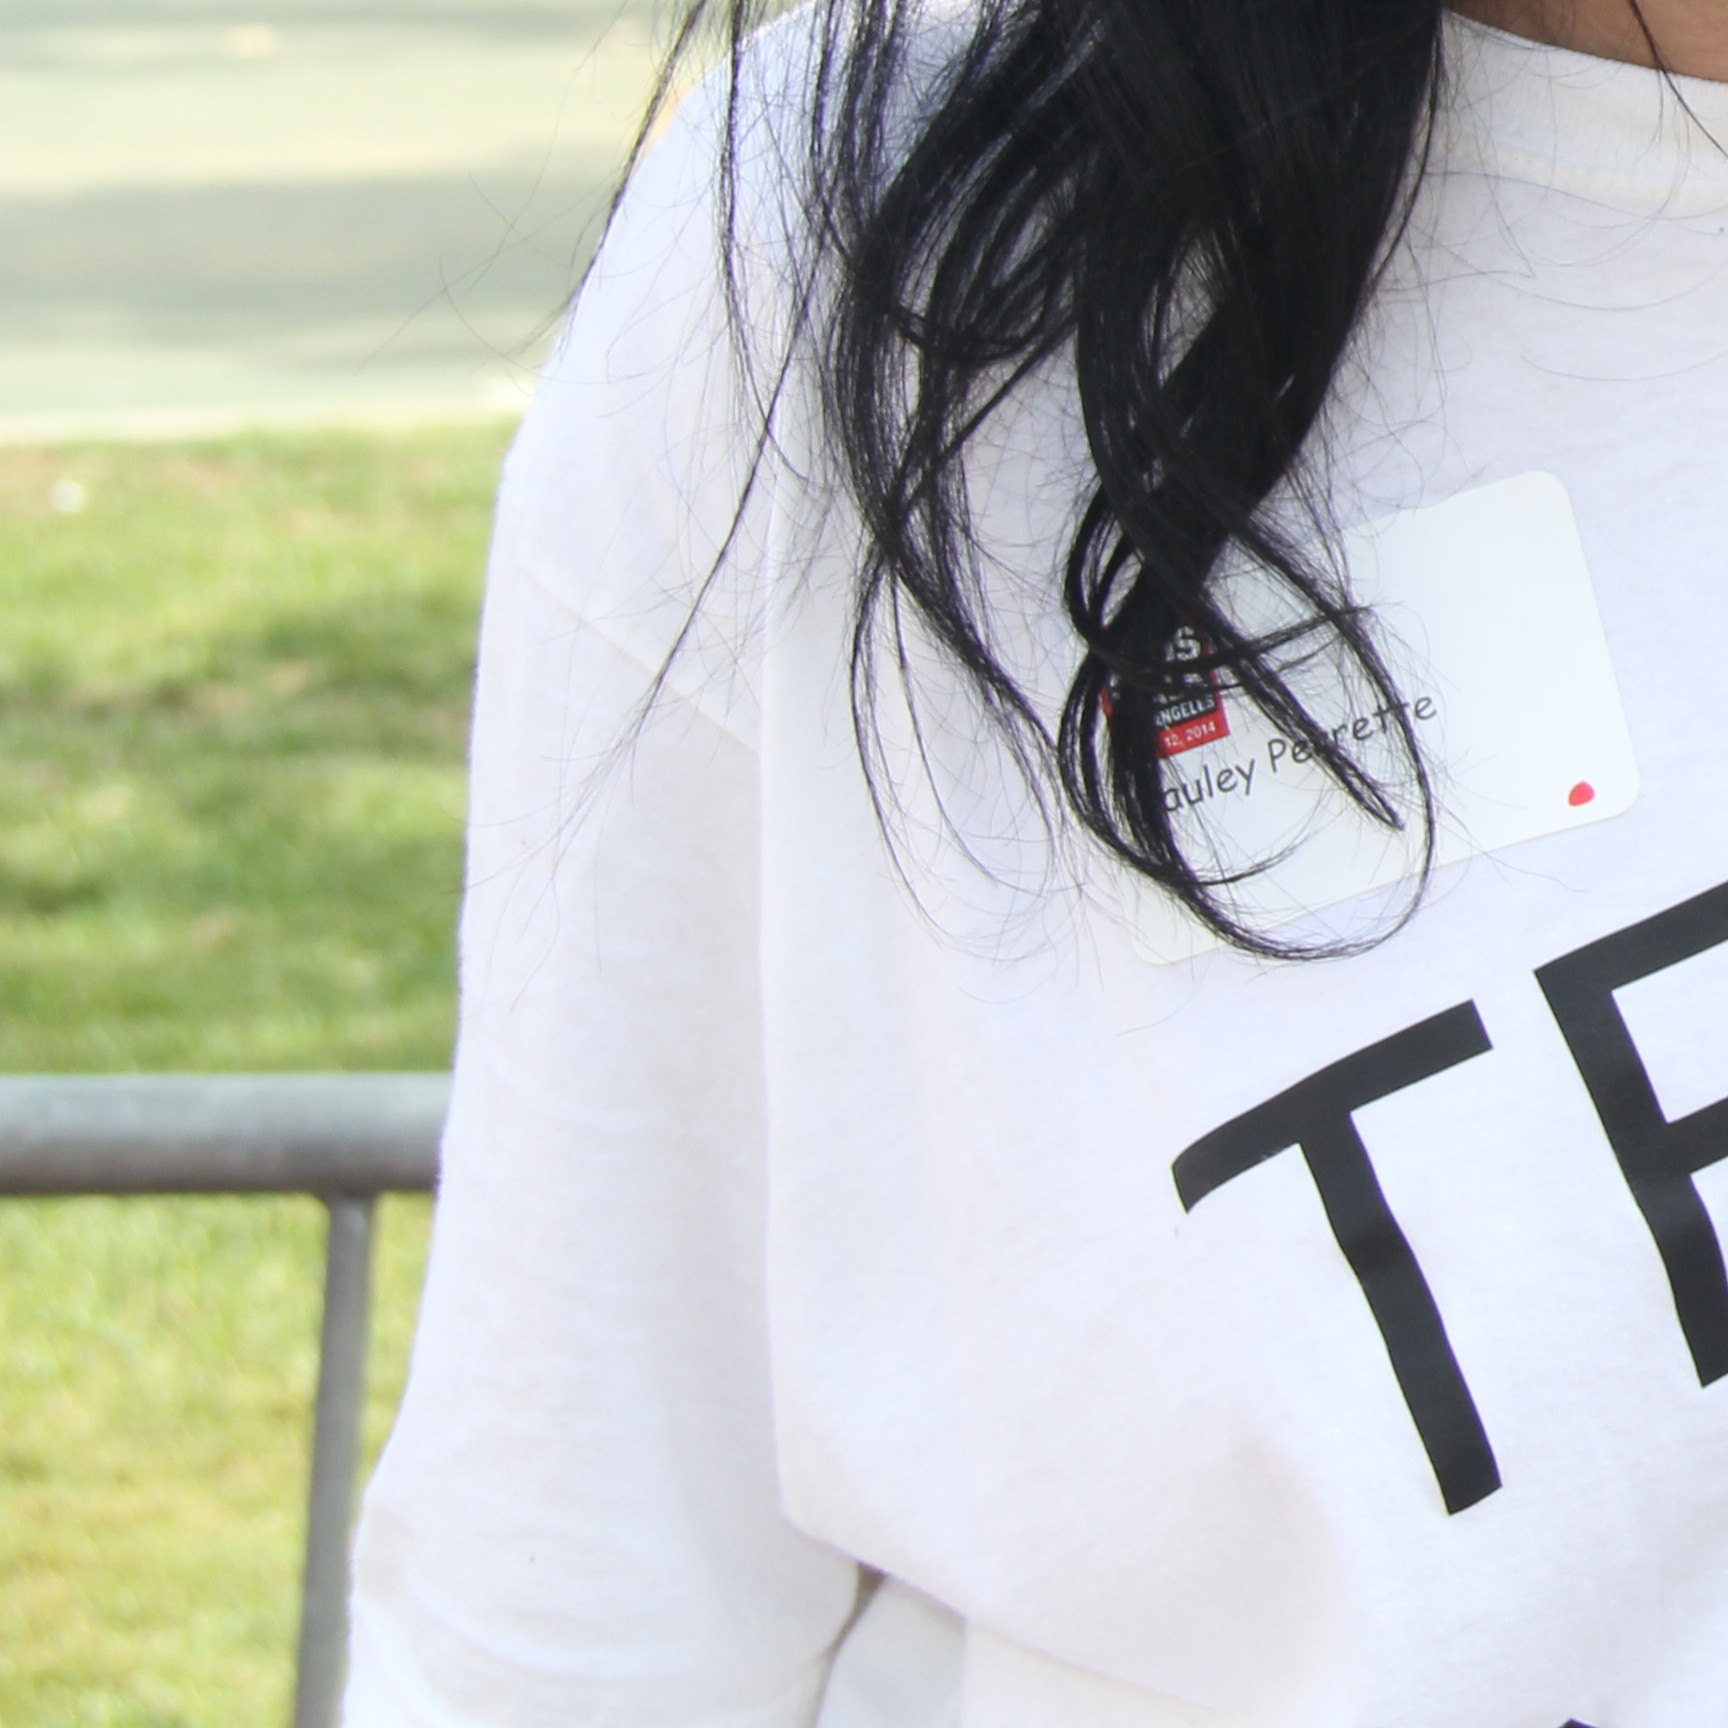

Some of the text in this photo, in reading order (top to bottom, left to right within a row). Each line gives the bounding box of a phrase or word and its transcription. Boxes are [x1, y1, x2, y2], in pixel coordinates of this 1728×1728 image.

[1165, 695, 1437, 813] auley Perette
[1185, 721, 1217, 741] 2014
